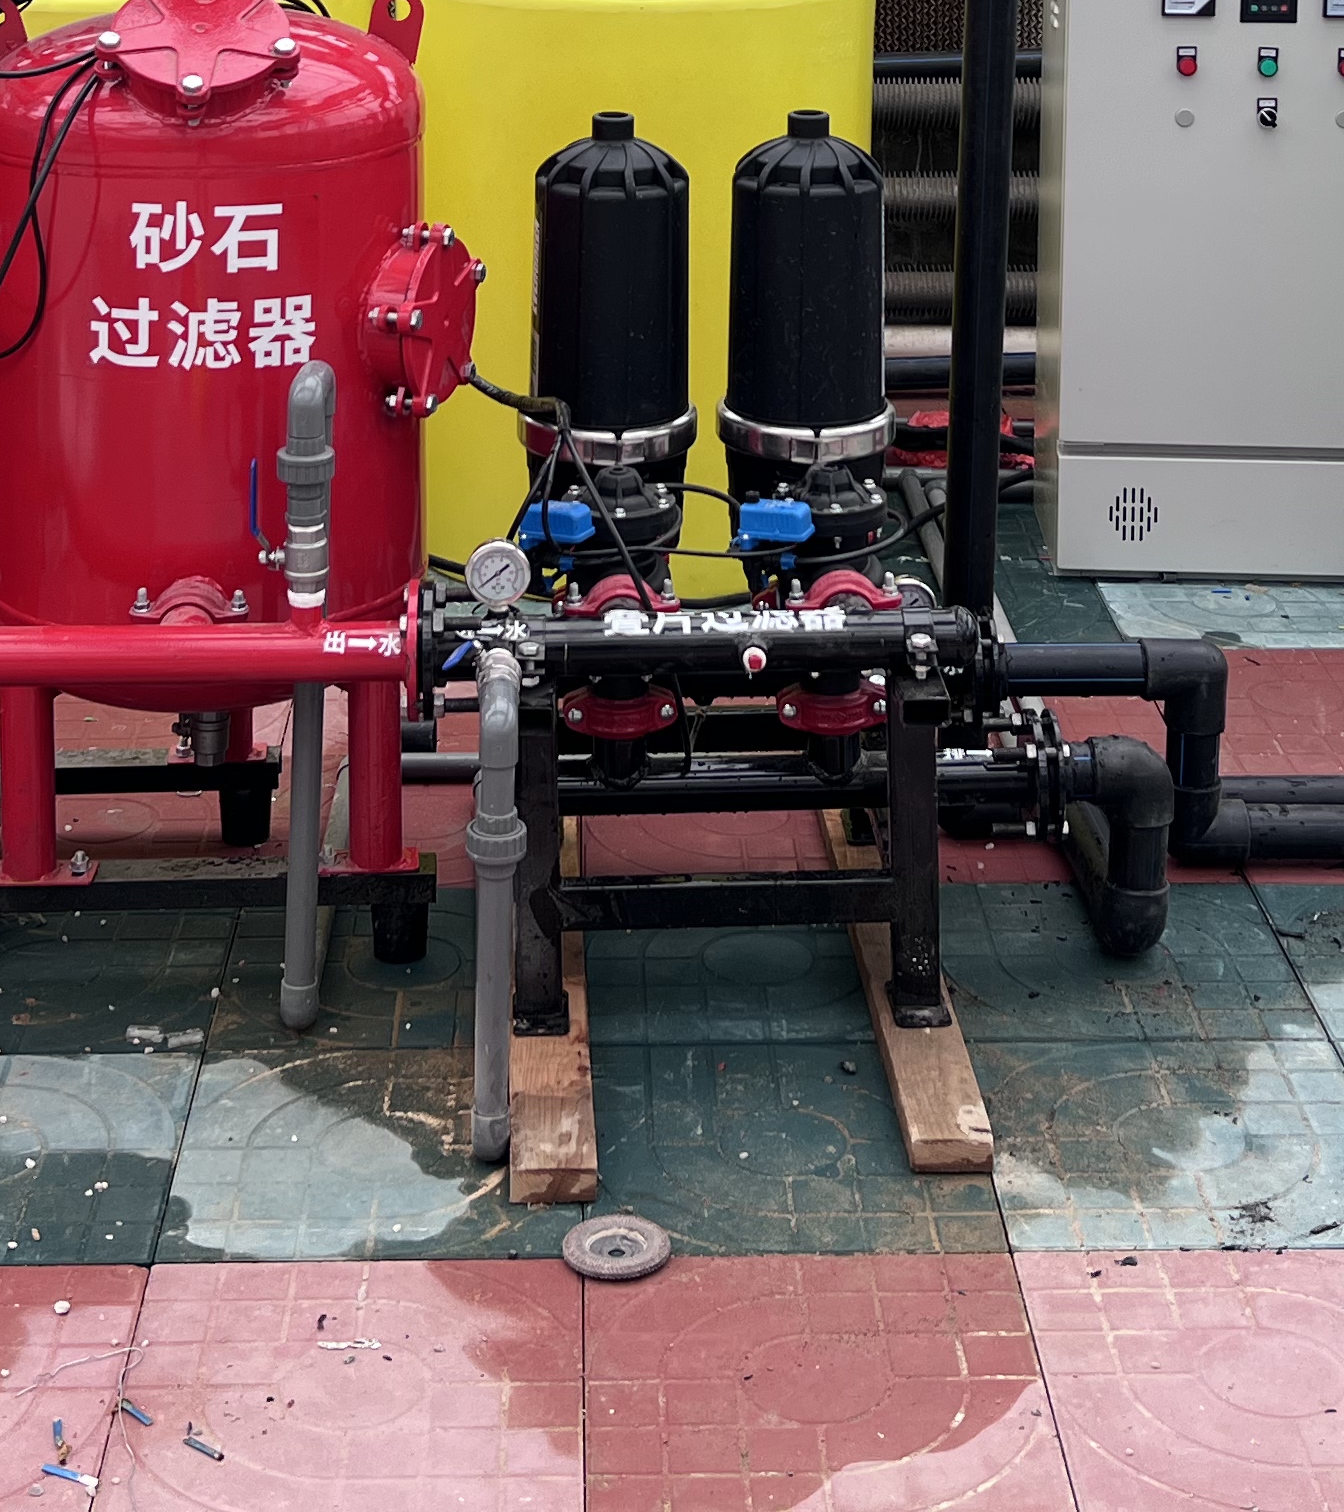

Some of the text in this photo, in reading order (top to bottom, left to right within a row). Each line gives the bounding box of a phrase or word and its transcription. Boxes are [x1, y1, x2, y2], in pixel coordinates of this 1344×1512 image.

[129, 200, 284, 274] 砂石
[89, 294, 316, 371] 过滤器
[323, 631, 402, 656] 出 水
